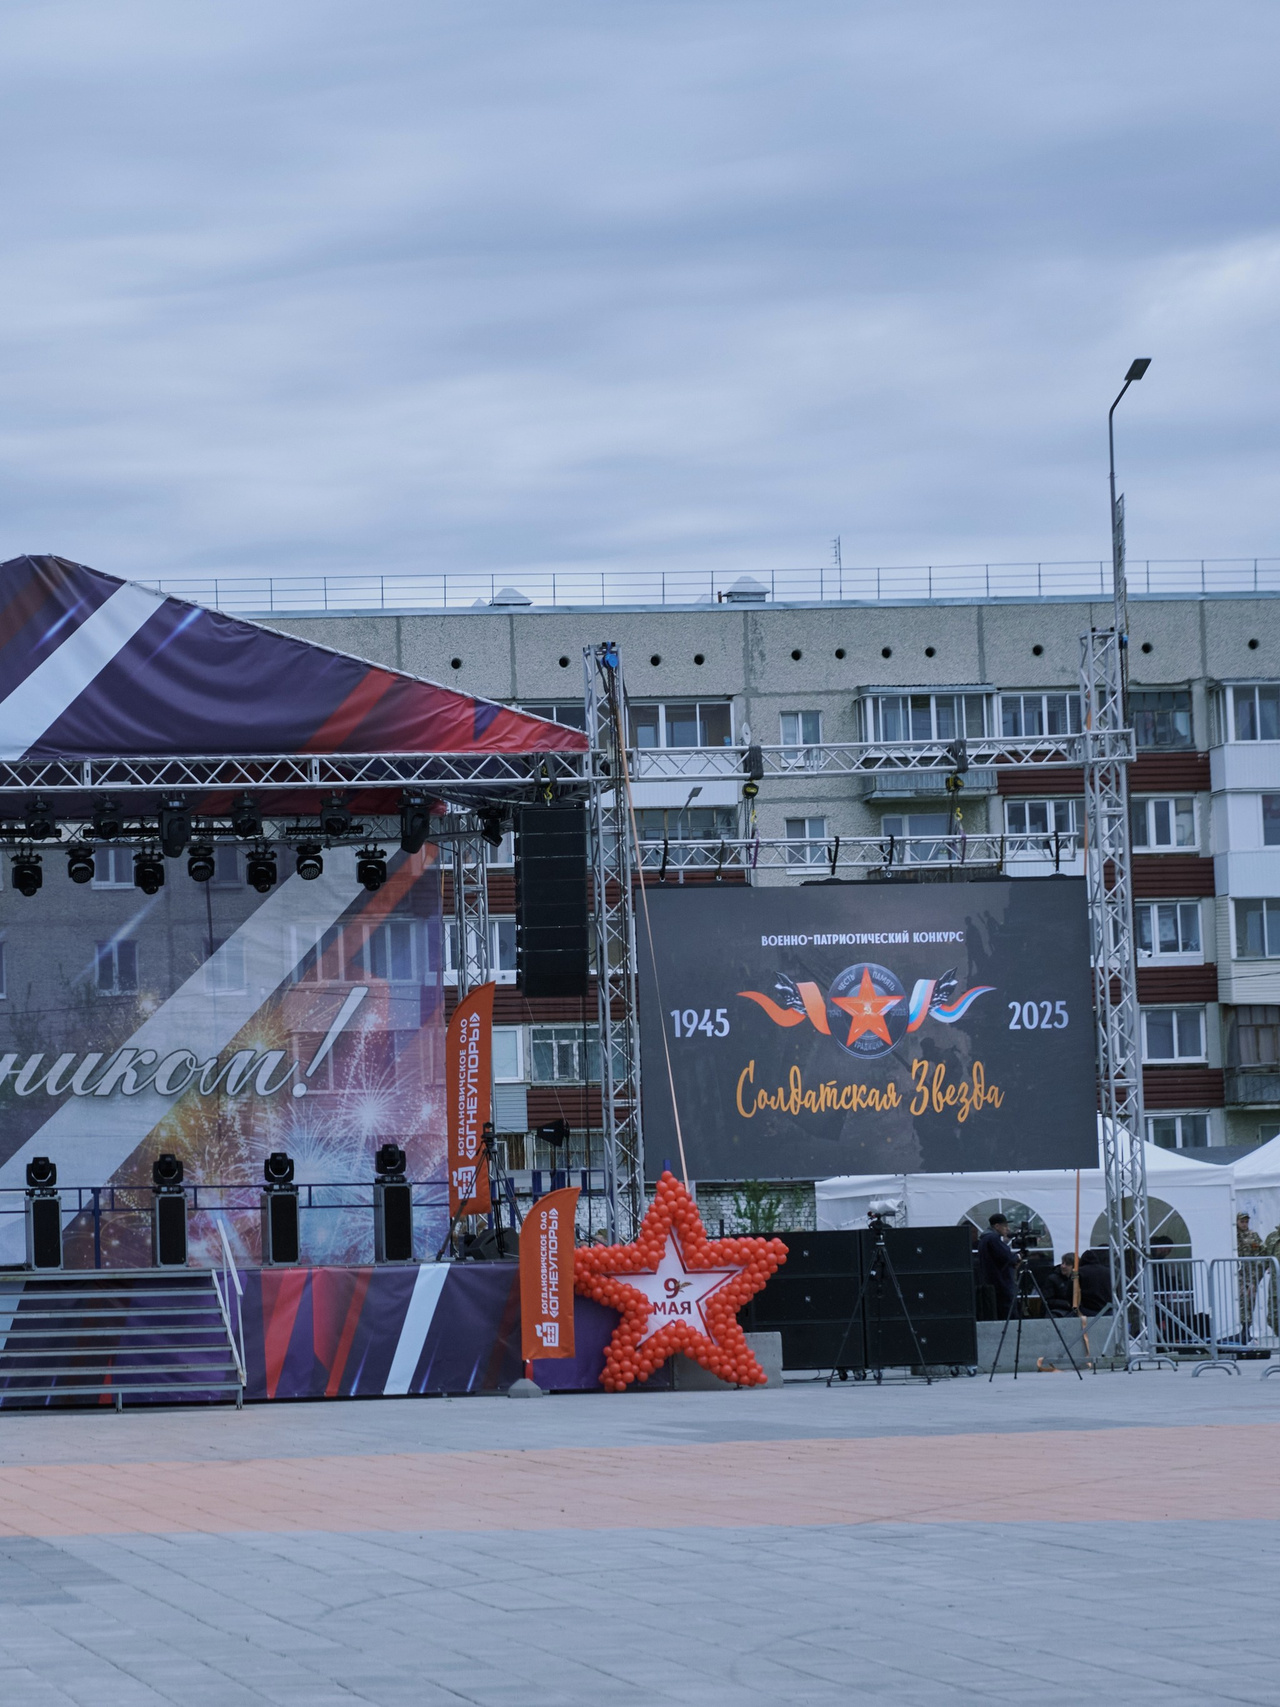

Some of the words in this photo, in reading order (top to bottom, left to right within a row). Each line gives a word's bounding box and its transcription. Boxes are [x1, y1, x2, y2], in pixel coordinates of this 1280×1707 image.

[761, 930, 909, 946] ВОЕННО-ПАТРИОТИЧЕСКИЙ
[913, 931, 964, 943] КОНКУРС
[837, 973, 856, 991] ЧЕСТЬ
[872, 971, 895, 992] ПАМЯТЬ
[670, 1008, 730, 1038] 1945
[1008, 1000, 1070, 1031] 2025
[459, 1018, 468, 1044] ОАО
[465, 1011, 480, 1160] «ОГНЕУПОРЫ»
[736, 1059, 903, 1118] Солдатская
[909, 1058, 1005, 1123] Звезда
[458, 1049, 467, 1157] БОГДАНОВИЧСКОЕ
[540, 1211, 548, 1231] ОАО
[540, 1234, 549, 1315] БОГДАНОВИЧСКОЕ
[548, 1207, 559, 1318] «ОГНЕУПОРЫ»
[663, 1278, 680, 1299] 9
[653, 1301, 692, 1315] МАЯ
